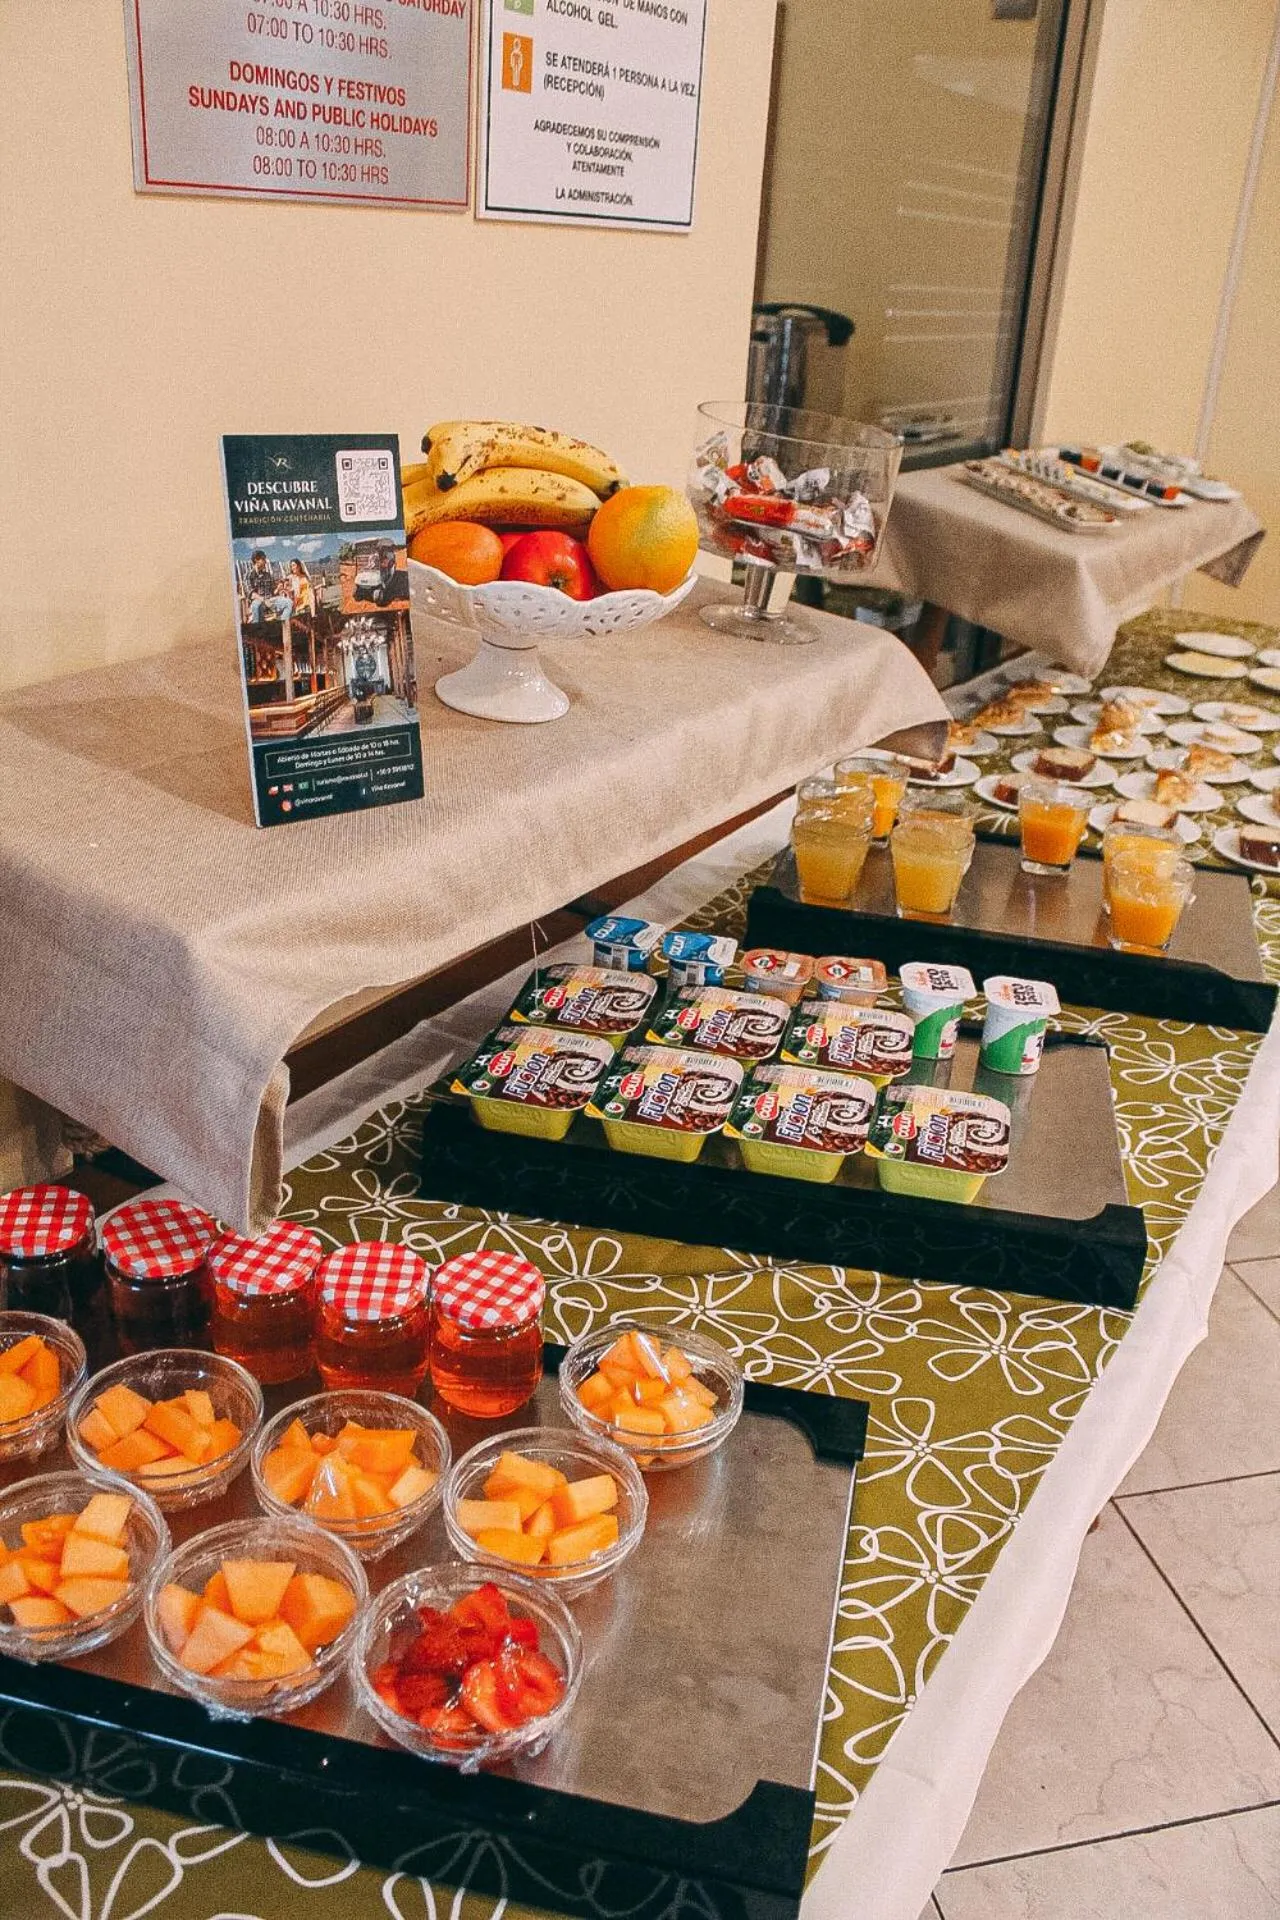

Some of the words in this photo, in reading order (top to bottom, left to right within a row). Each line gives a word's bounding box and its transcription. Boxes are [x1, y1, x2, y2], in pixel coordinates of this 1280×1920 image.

[314, 0, 350, 21] 10:30
[354, 6, 387, 30] HRS.
[547, 0, 593, 22] ALCOHOL
[670, 8, 688, 26] CON
[247, 12, 288, 39] 07:00
[292, 21, 314, 44] TO
[319, 28, 355, 51] 10:30
[359, 35, 392, 59] HRS.
[230, 61, 319, 93] DOMINGOS
[324, 75, 333, 93] Y
[338, 79, 406, 106] FESTIVOS
[545, 51, 558, 67] SE
[561, 56, 610, 76] ATENDERÁ
[613, 67, 617, 79] 1
[619, 68, 659, 88] PERSONA
[661, 78, 667, 89] A
[669, 81, 678, 92] LA
[544, 73, 604, 101] (RECEPCIÓN)
[189, 86, 269, 116] SUNDAYS
[274, 99, 307, 120] AND
[312, 105, 365, 128] PUBLIC
[370, 113, 438, 138] HOLIDAYS
[256, 126, 295, 148] 08:00
[299, 130, 310, 148] A
[314, 133, 350, 153] 10:30
[354, 138, 386, 158] HRS.
[534, 120, 595, 139] AGRADECEMOS
[597, 129, 607, 141] SU
[609, 131, 660, 148] COMPRENSIÓN
[566, 142, 572, 153] Y
[253, 155, 292, 177] 08:00
[297, 159, 317, 178] TO
[322, 163, 357, 182] 10:30
[361, 165, 389, 184] HRS
[572, 160, 624, 177] ATENTAMENTE
[555, 187, 565, 199] LA
[247, 480, 318, 495] DESCUBRE
[234, 497, 270, 513] VIÑA
[273, 497, 332, 512] RAVANAL
[238, 516, 282, 525] TRADICIÓN
